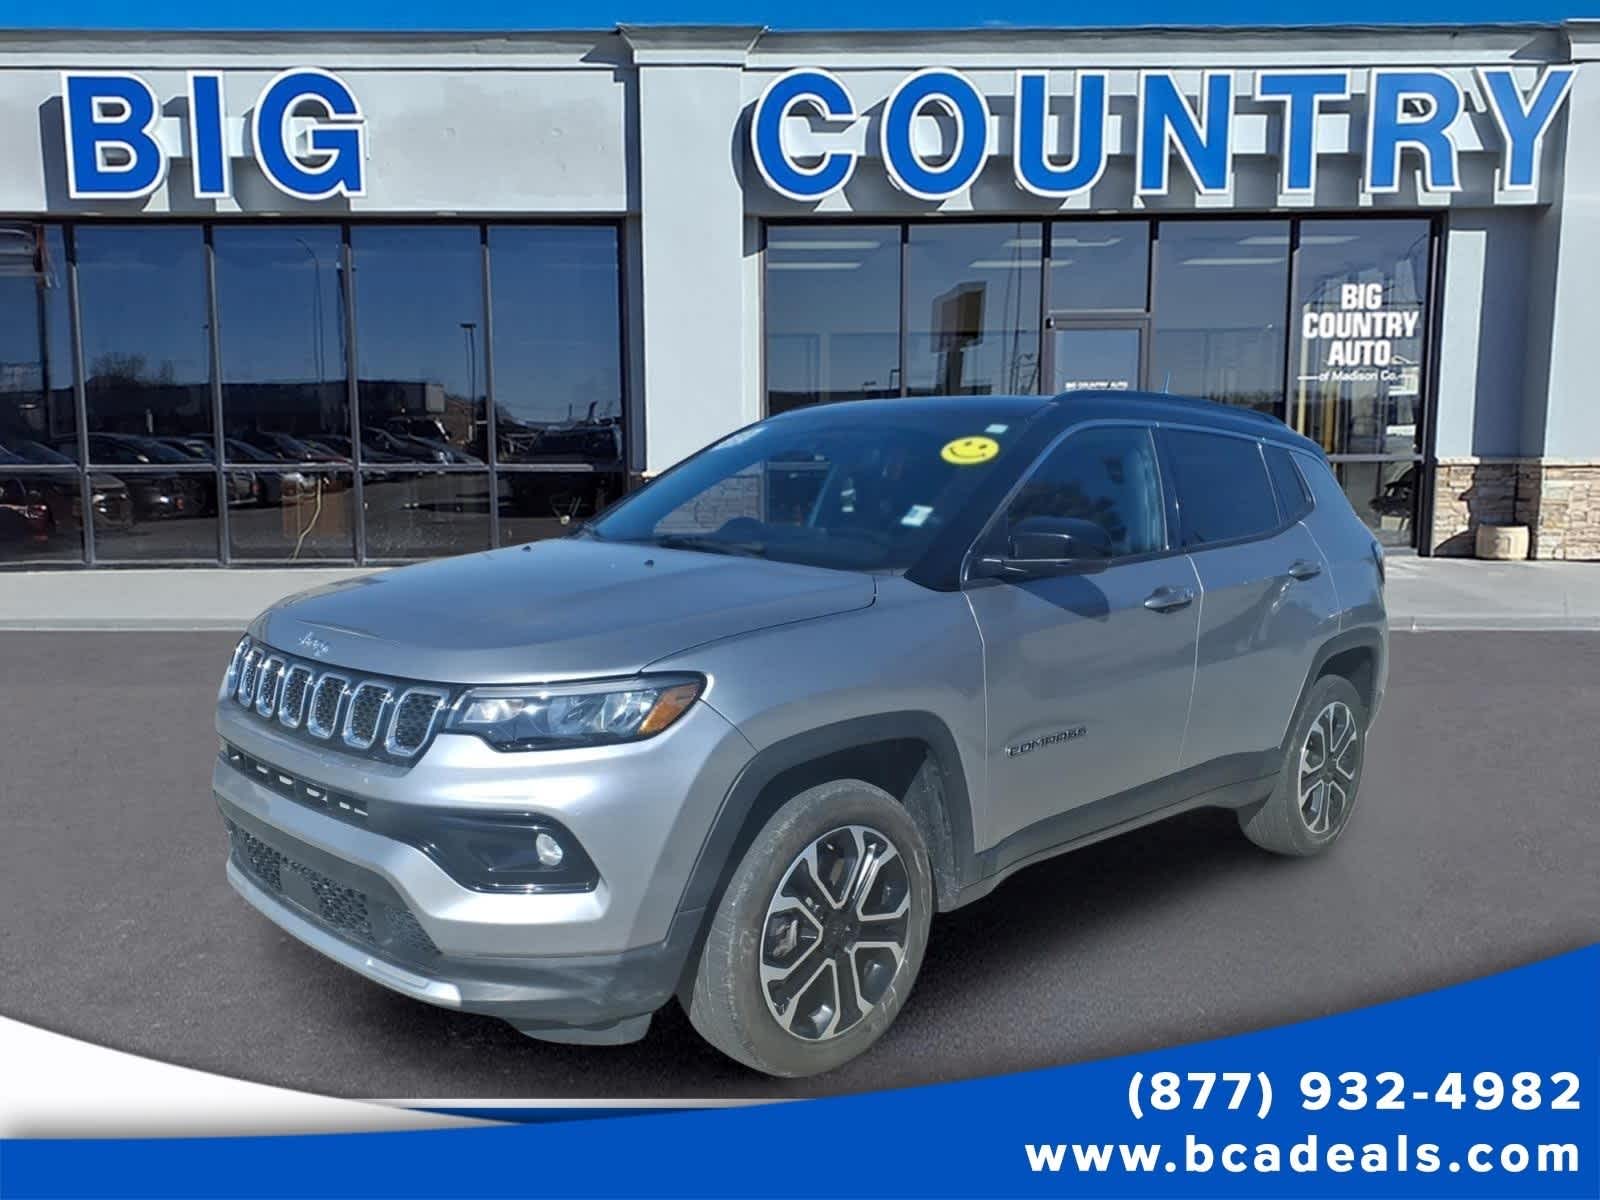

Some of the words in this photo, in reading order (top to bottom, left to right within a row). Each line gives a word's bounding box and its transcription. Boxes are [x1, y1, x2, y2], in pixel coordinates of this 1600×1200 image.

[61, 67, 367, 200] BIG
[751, 67, 1577, 201] COUNTRY
[1341, 283, 1383, 310] BIG
[1303, 311, 1419, 339] COUNTRY
[1328, 340, 1392, 367] AUTO
[1331, 371, 1378, 381] Madison
